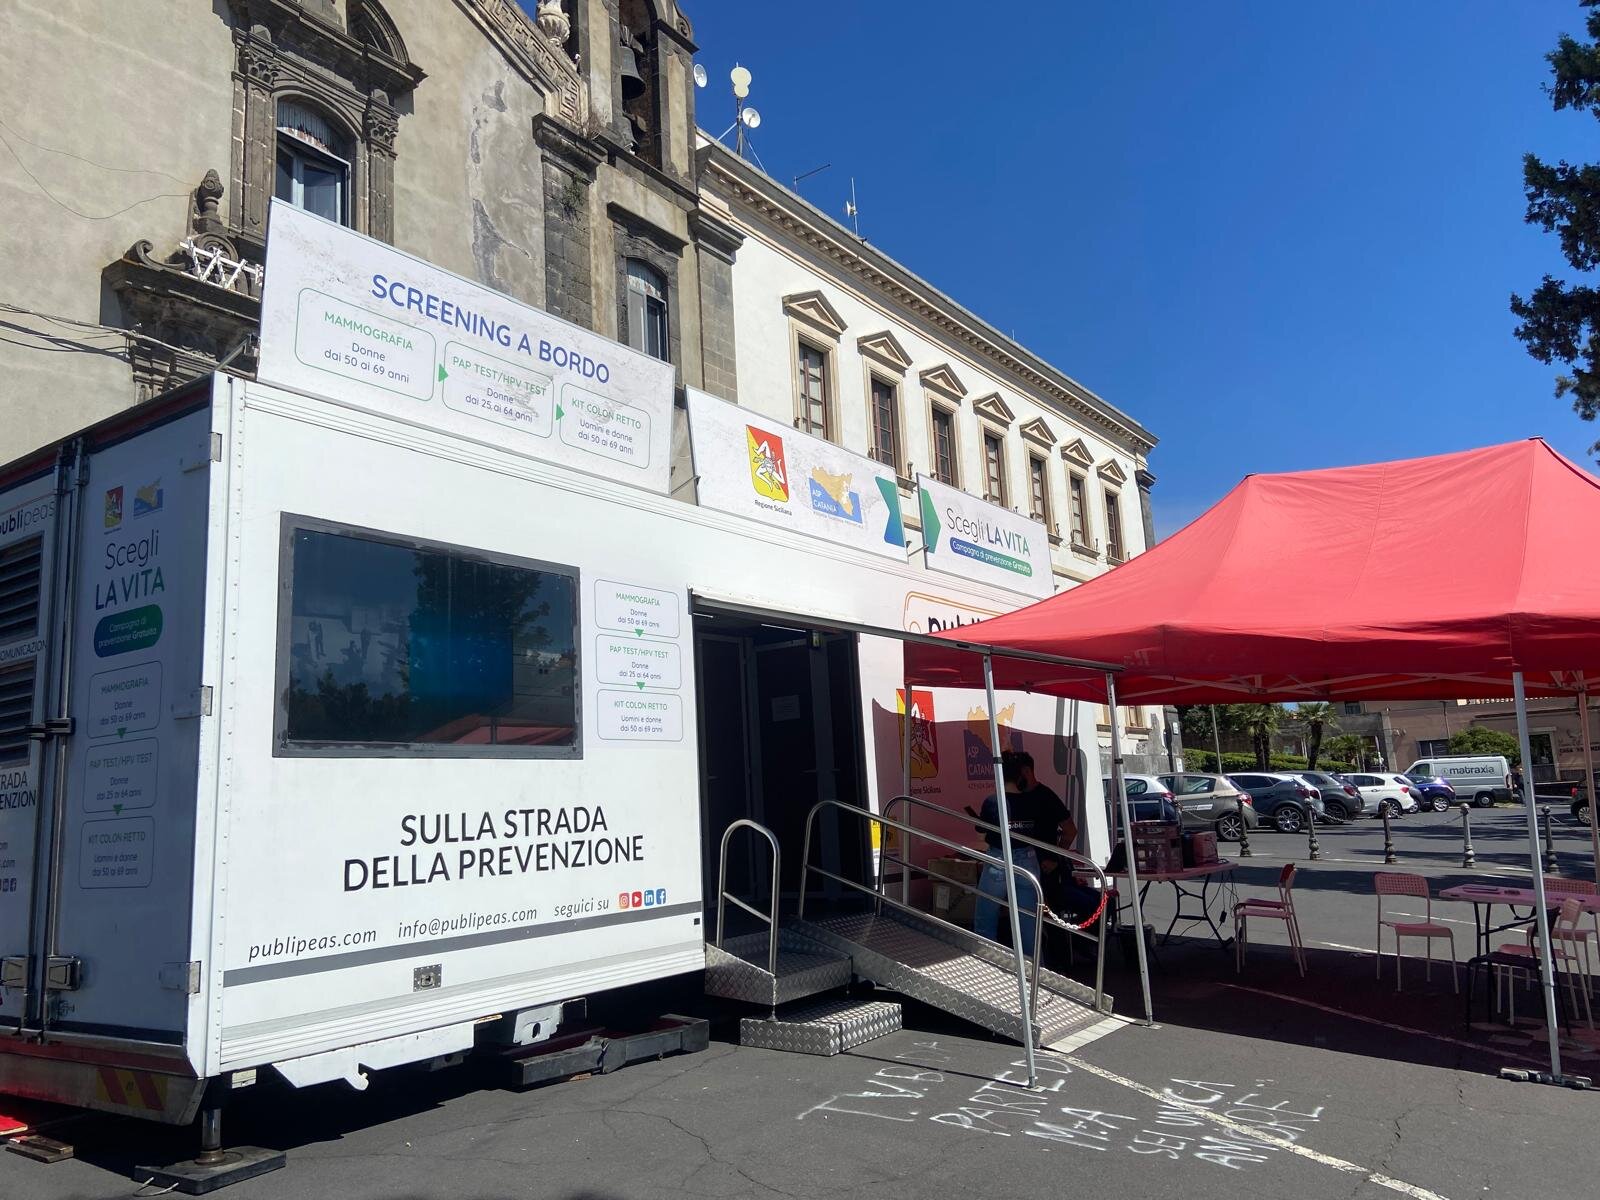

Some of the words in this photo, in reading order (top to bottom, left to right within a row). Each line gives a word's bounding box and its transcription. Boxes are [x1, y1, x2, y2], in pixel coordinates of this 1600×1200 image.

[324, 311, 413, 351] MAMMOGRAFIA
[372, 274, 511, 347] SCREENING
[518, 333, 532, 356] A
[539, 341, 610, 385] BORDO
[324, 347, 342, 363] dai
[344, 352, 358, 367] 50
[361, 356, 371, 370] ai
[372, 361, 386, 375] 69
[388, 367, 410, 384] anni
[352, 342, 386, 362] Donne
[452, 356, 472, 371] PAP
[474, 362, 521, 389] TEST/HPV
[523, 379, 546, 397] TEST
[466, 393, 479, 407] dai
[481, 398, 492, 410] 25
[493, 402, 502, 413] ai
[503, 405, 514, 417] 64
[515, 410, 533, 424] anni
[486, 387, 514, 404] Donne
[572, 397, 584, 411] KIT
[586, 403, 614, 421] COLON
[616, 412, 642, 429] RETTO
[578, 430, 589, 441] dai
[591, 433, 600, 445] 50
[601, 436, 608, 448] ai
[609, 440, 619, 451] 69
[620, 444, 634, 456] anni
[580, 419, 603, 434] Uomini
[612, 427, 633, 444] donne
[0, 501, 55, 535] ublipeas
[946, 508, 984, 543] Scegli
[105, 529, 159, 570] Scegli
[121, 567, 165, 602] VITA
[616, 592, 660, 607] MAMMOGRAFIA
[630, 608, 648, 617] Donne
[631, 662, 649, 670] Donne
[654, 651, 668, 659] TEST
[0, 771, 27, 790] RADA
[1450, 766, 1494, 775] matraxia
[400, 811, 497, 846] SULLA
[504, 806, 608, 839] STRADA
[344, 852, 450, 892] DELLA
[459, 835, 644, 879] PREVENZIONE
[248, 928, 377, 962] publipeas.com
[398, 907, 537, 938] info@publipeas.com
[554, 898, 595, 917] seguici
[597, 897, 609, 910] su
